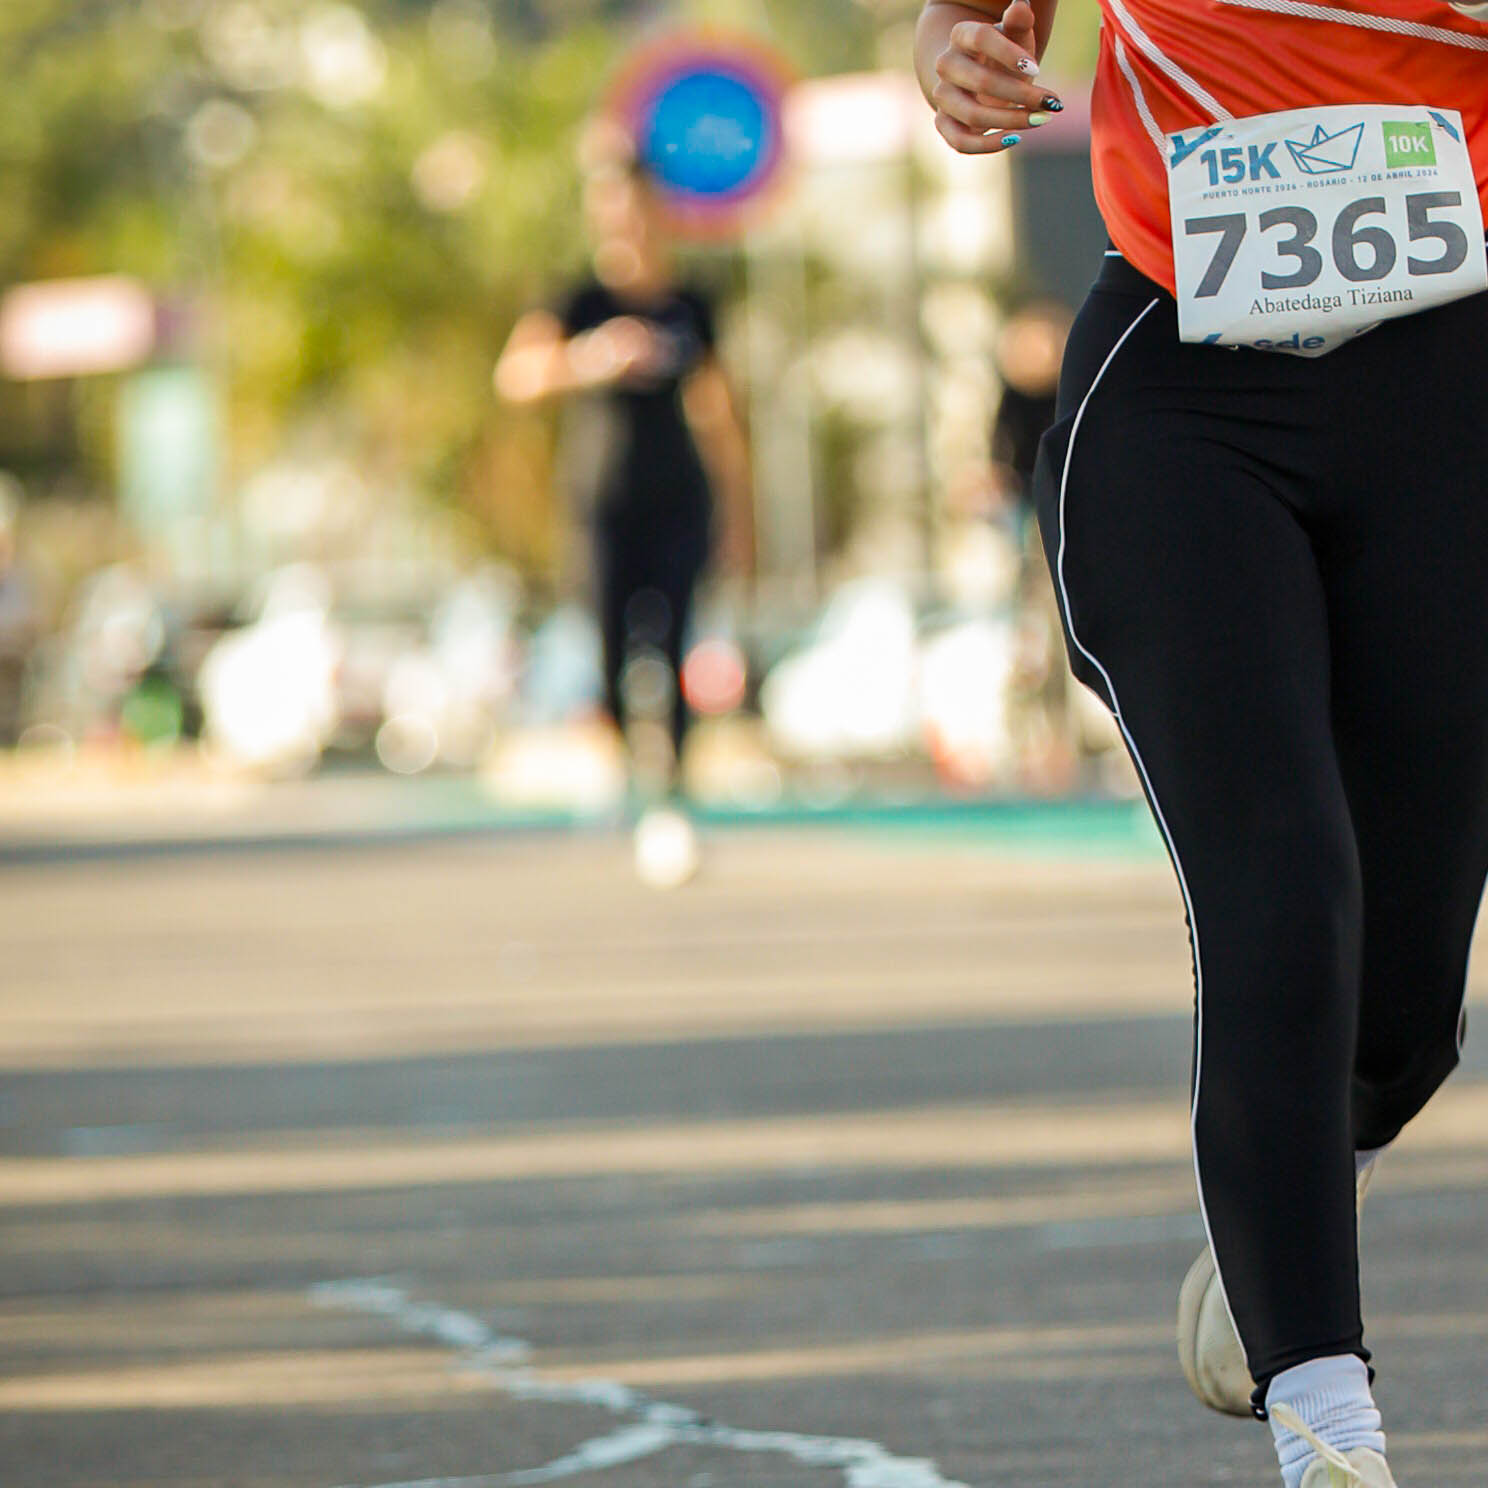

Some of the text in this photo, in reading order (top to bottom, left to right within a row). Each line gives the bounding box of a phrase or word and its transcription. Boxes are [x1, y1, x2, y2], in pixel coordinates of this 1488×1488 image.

[1388, 133, 1430, 155] 10K
[1199, 141, 1281, 186] 15K
[1202, 189, 1239, 200] PUERTO
[1242, 185, 1272, 196] NORTE
[1306, 177, 1347, 189] ROSARIO
[1357, 175, 1367, 183] 12
[1184, 191, 1469, 299] 7365
[1250, 287, 1414, 315] Abatedaga Tiziana
